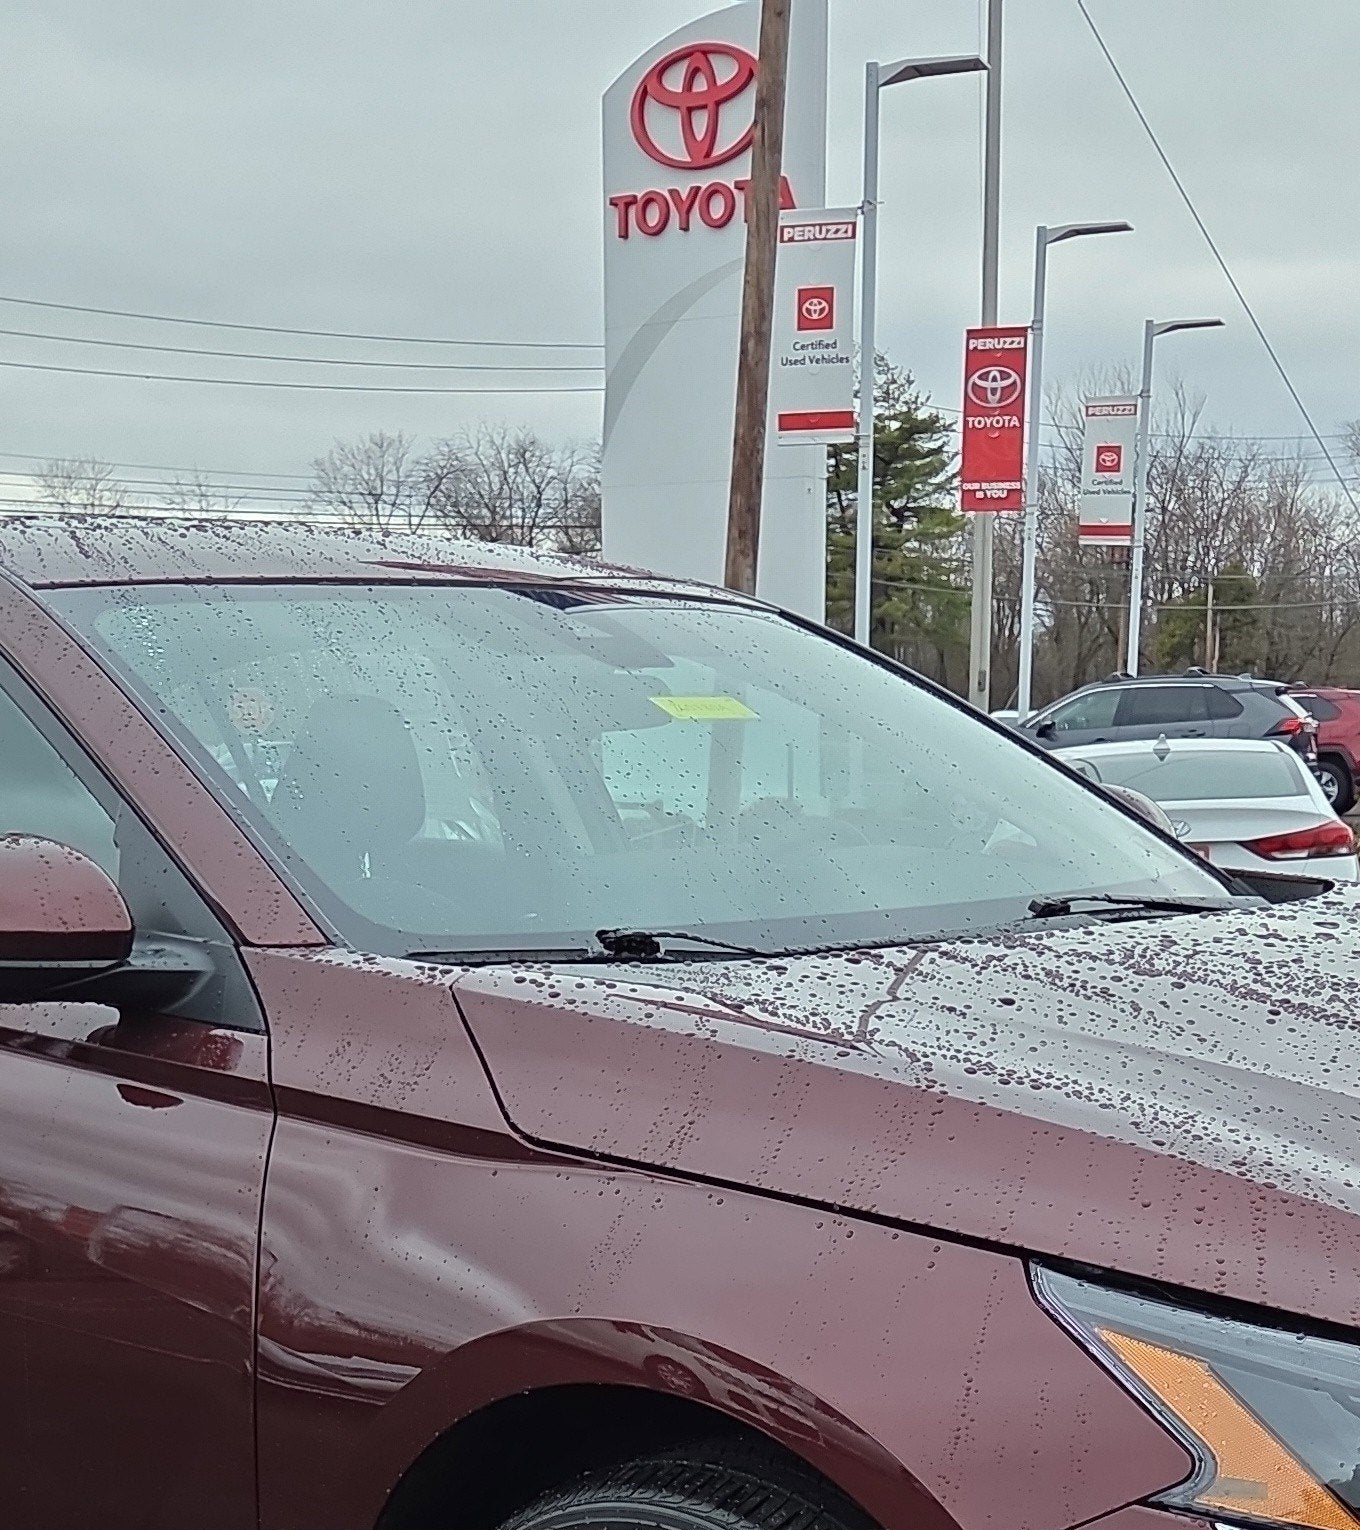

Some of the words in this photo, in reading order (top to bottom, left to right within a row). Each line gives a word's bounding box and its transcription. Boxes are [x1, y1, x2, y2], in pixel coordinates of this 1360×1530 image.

[783, 223, 853, 242] PERUZZI
[792, 339, 838, 351] Certified
[968, 336, 1025, 350] PERUZZI
[780, 355, 807, 367] Used
[808, 354, 850, 365] Vehicles
[965, 415, 1020, 429] TOYOTA
[985, 489, 1008, 498] YOU
